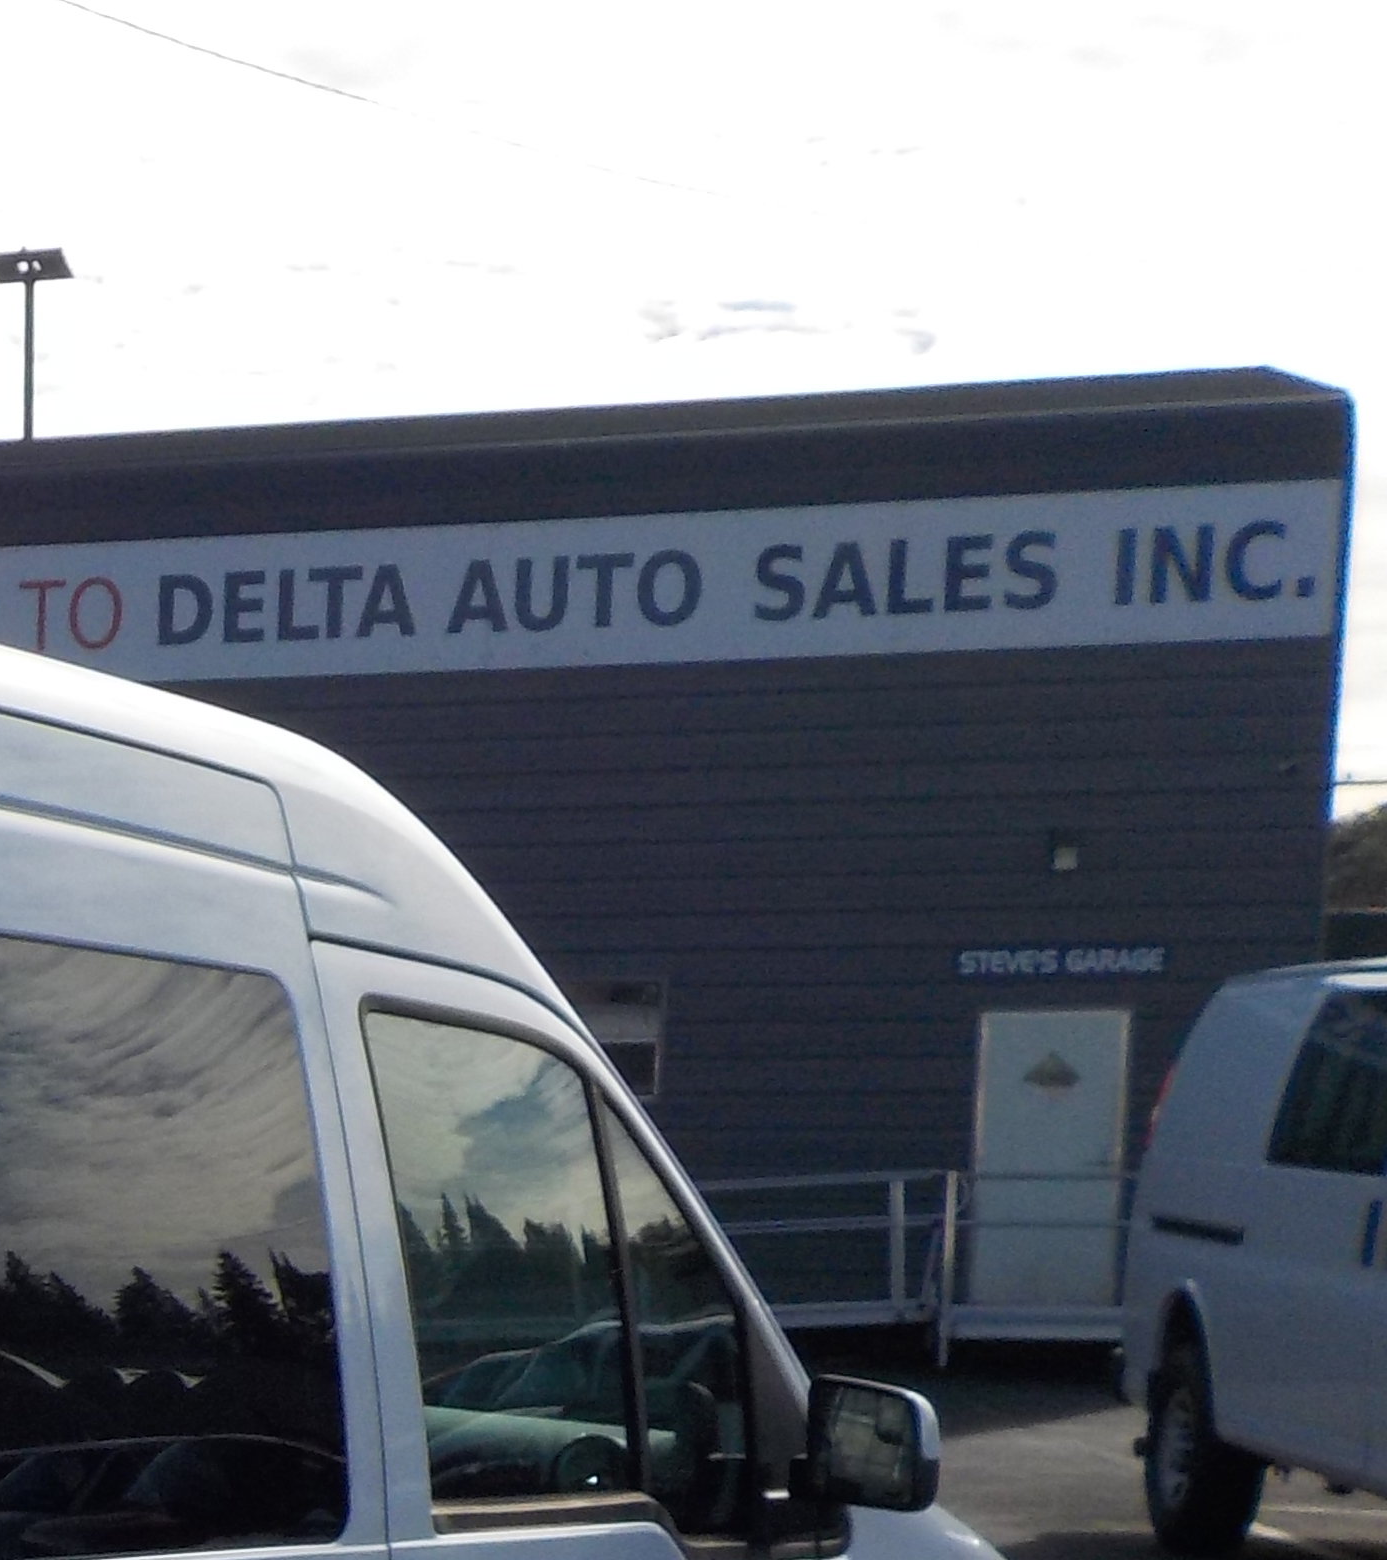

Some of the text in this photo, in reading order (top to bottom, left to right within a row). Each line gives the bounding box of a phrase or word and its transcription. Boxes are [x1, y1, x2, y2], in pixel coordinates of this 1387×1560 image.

[20, 576, 123, 651] TO
[157, 564, 415, 646] DELTA
[446, 548, 704, 635] AUTO
[752, 530, 1060, 622] SALES
[1112, 519, 1318, 607] INC.
[1065, 947, 1166, 974] GARAGE
